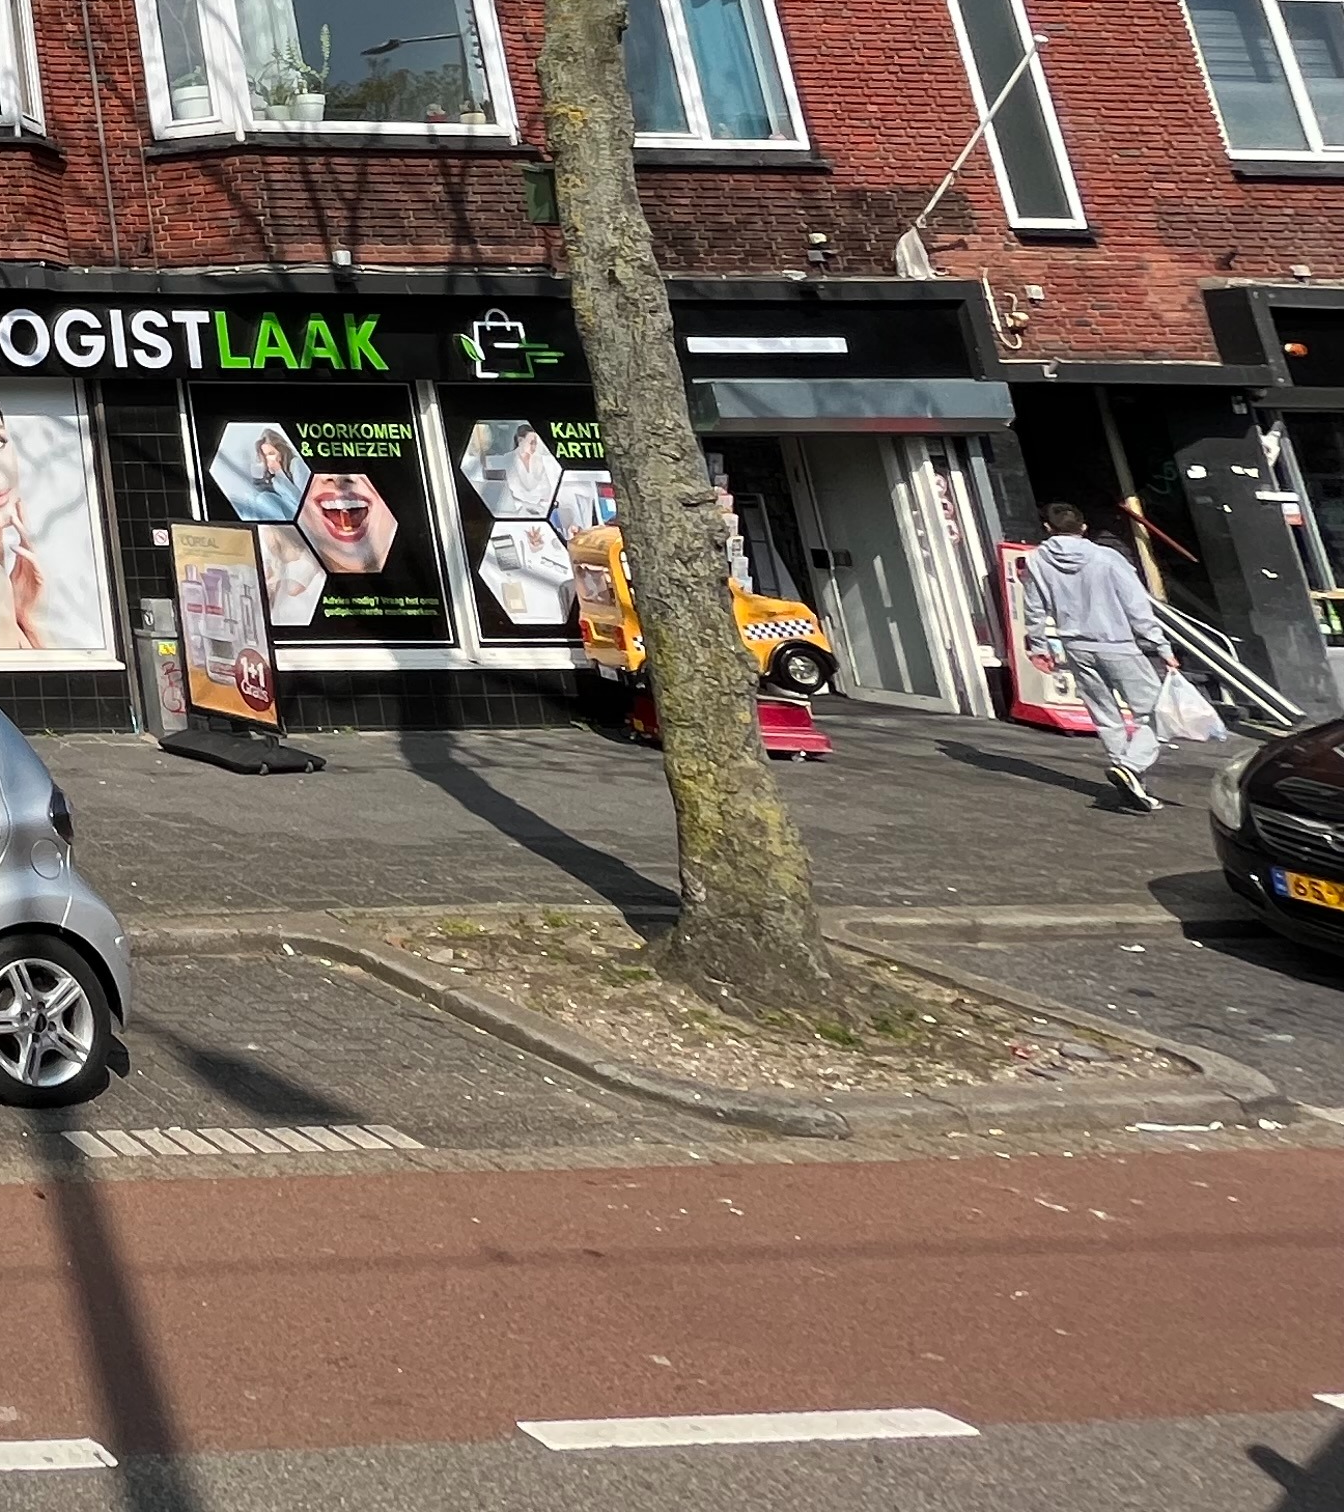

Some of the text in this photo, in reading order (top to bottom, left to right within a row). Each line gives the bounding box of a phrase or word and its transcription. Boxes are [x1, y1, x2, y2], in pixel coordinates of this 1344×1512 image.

[296, 423, 412, 440] VOORKOMEN
[300, 441, 402, 457] & GENEZEN
[240, 656, 265, 688] 1+1
